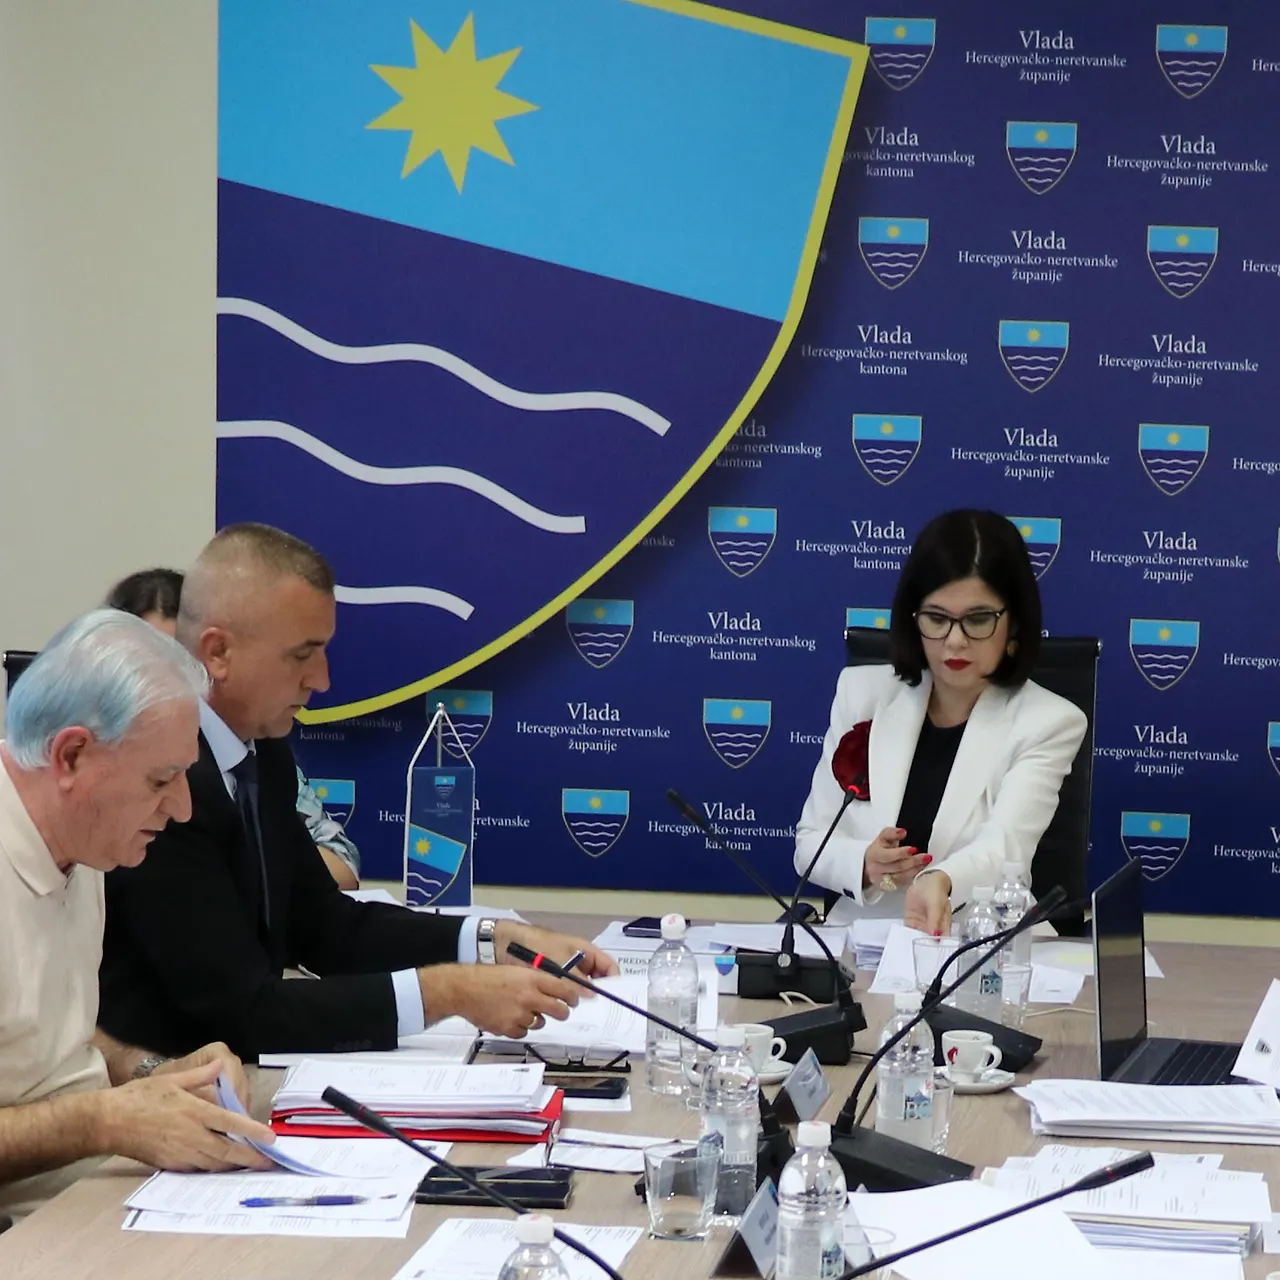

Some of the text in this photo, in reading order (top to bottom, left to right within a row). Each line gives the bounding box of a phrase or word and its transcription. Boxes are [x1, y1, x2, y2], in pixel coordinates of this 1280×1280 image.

[1020, 30, 1074, 49] Vlada
[966, 52, 1126, 67] Hercegovačko-neretvanske
[1020, 70, 1070, 84] županije
[866, 127, 918, 146] Vlada
[1161, 134, 1215, 154] Vlada
[867, 165, 913, 177] kantona
[1108, 156, 1268, 172] Hercegovačko-neretvanske
[1161, 174, 1212, 188] županije
[1012, 230, 1066, 250] Vlada
[959, 251, 1118, 267] Hercegovačko-neretvanske
[1012, 269, 1062, 284] županije
[858, 324, 912, 344] Vlada
[1152, 334, 1206, 354] Vlada
[801, 346, 967, 364] Hercegovačko-neretvanskog
[1099, 354, 1258, 371] Hercegovačko-neretvanske
[860, 362, 906, 375] kantona
[1152, 373, 1202, 388] županije
[1004, 428, 1058, 447] Vlada
[952, 448, 1109, 464] Hercegovačko-neretvanske
[1005, 466, 1054, 481] županije
[852, 520, 905, 539] Vlada
[796, 540, 912, 555] Hercegovačko-neret
[1143, 531, 1197, 550] Vlada
[854, 556, 900, 569] kantona
[1091, 550, 1248, 568] Hercegovačko-neretvanske
[1144, 569, 1193, 584] županije
[708, 612, 761, 630] Vlada
[653, 631, 816, 651] Hercegovačko-neretvanskog
[710, 648, 756, 660] kantona
[567, 702, 620, 721] Vlada
[517, 722, 670, 738] Hercegovačko-neretvanske
[1134, 725, 1187, 744] Vlada
[569, 740, 617, 754] županije
[1094, 747, 1239, 764] ercegovačko-neretvanske
[1135, 762, 1184, 777] županije
[703, 802, 756, 820] Vlada
